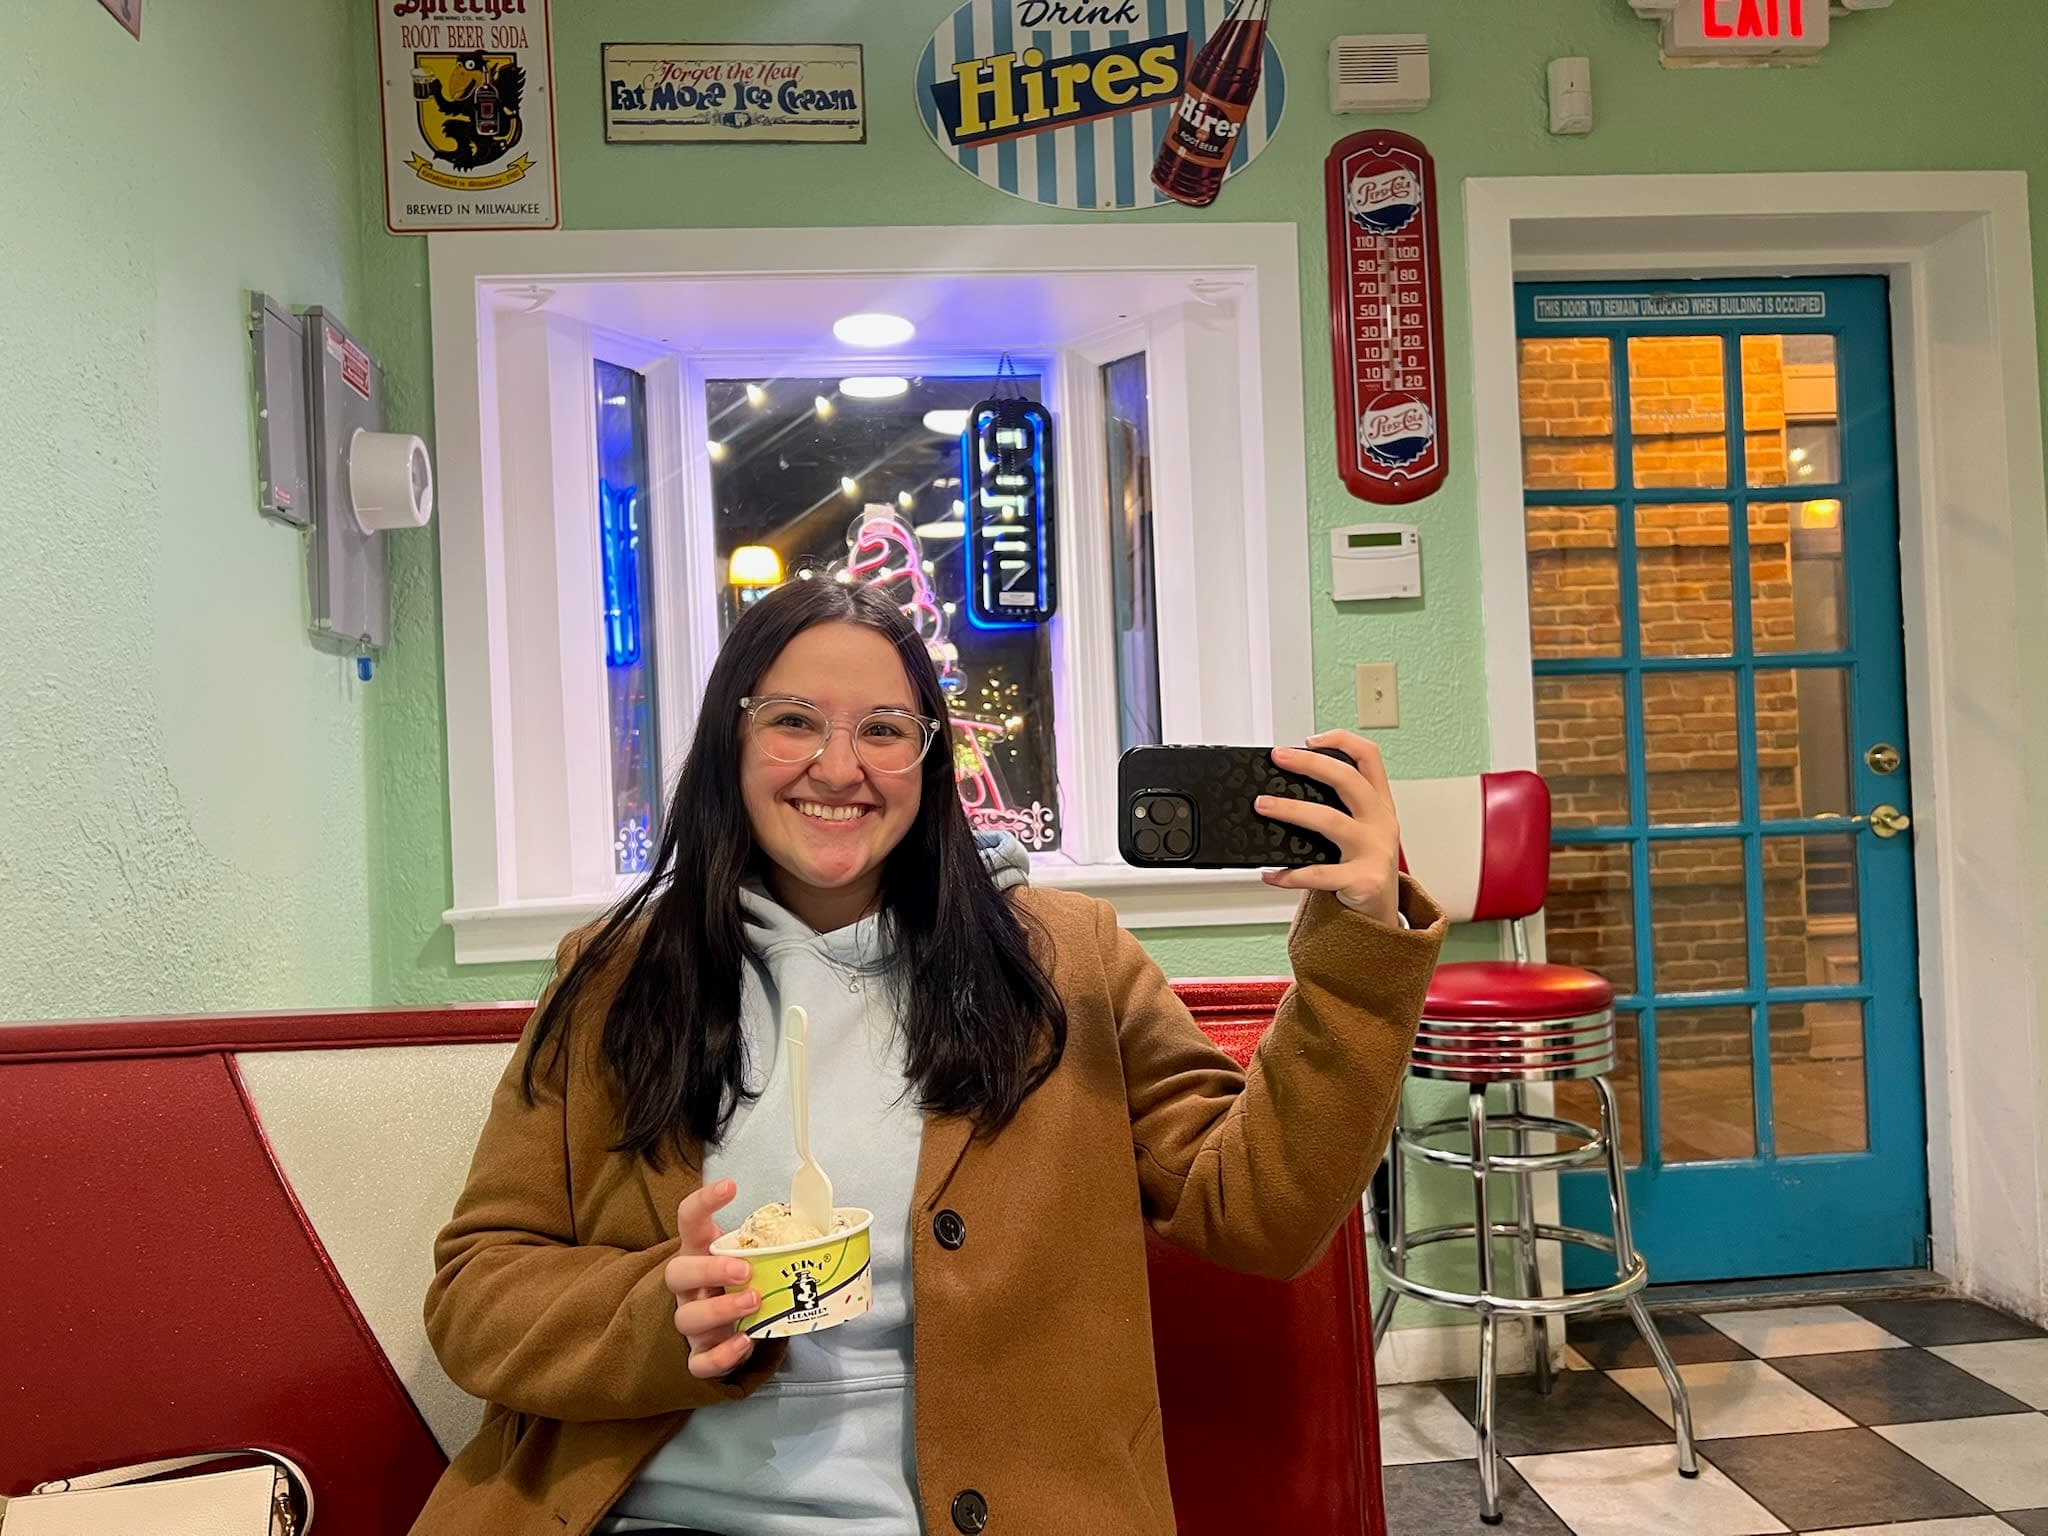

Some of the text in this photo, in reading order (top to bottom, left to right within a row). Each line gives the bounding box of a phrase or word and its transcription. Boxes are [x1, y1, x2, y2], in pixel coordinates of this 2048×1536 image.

[1018, 0, 1140, 27] Drink
[402, 25, 529, 48] ROOT BEER SODA
[658, 60, 803, 86] Forget the Heat
[952, 44, 1179, 137] Hires
[610, 80, 857, 114] Eat More Ice Cream
[1178, 93, 1240, 138] Hires
[406, 203, 540, 215] BREWED IN MILWAUKEE
[1356, 237, 1374, 247] 110
[1398, 247, 1419, 258] 100
[1358, 260, 1375, 271] 90
[1400, 269, 1417, 281] 80
[1359, 282, 1376, 293] 70
[1401, 292, 1419, 303] 60
[1360, 304, 1377, 315] 50
[1538, 296, 1821, 317] THIS DOOR TO REMAIN UNLOCKED WHEN BUILDING IS OCCUPIED
[1403, 314, 1419, 325] 40
[1361, 327, 1378, 338] 30
[1403, 335, 1420, 346] 20
[1365, 347, 1380, 358] 10
[1408, 356, 1417, 367] 0
[1366, 367, 1381, 378] 10
[1405, 375, 1422, 387] 20
